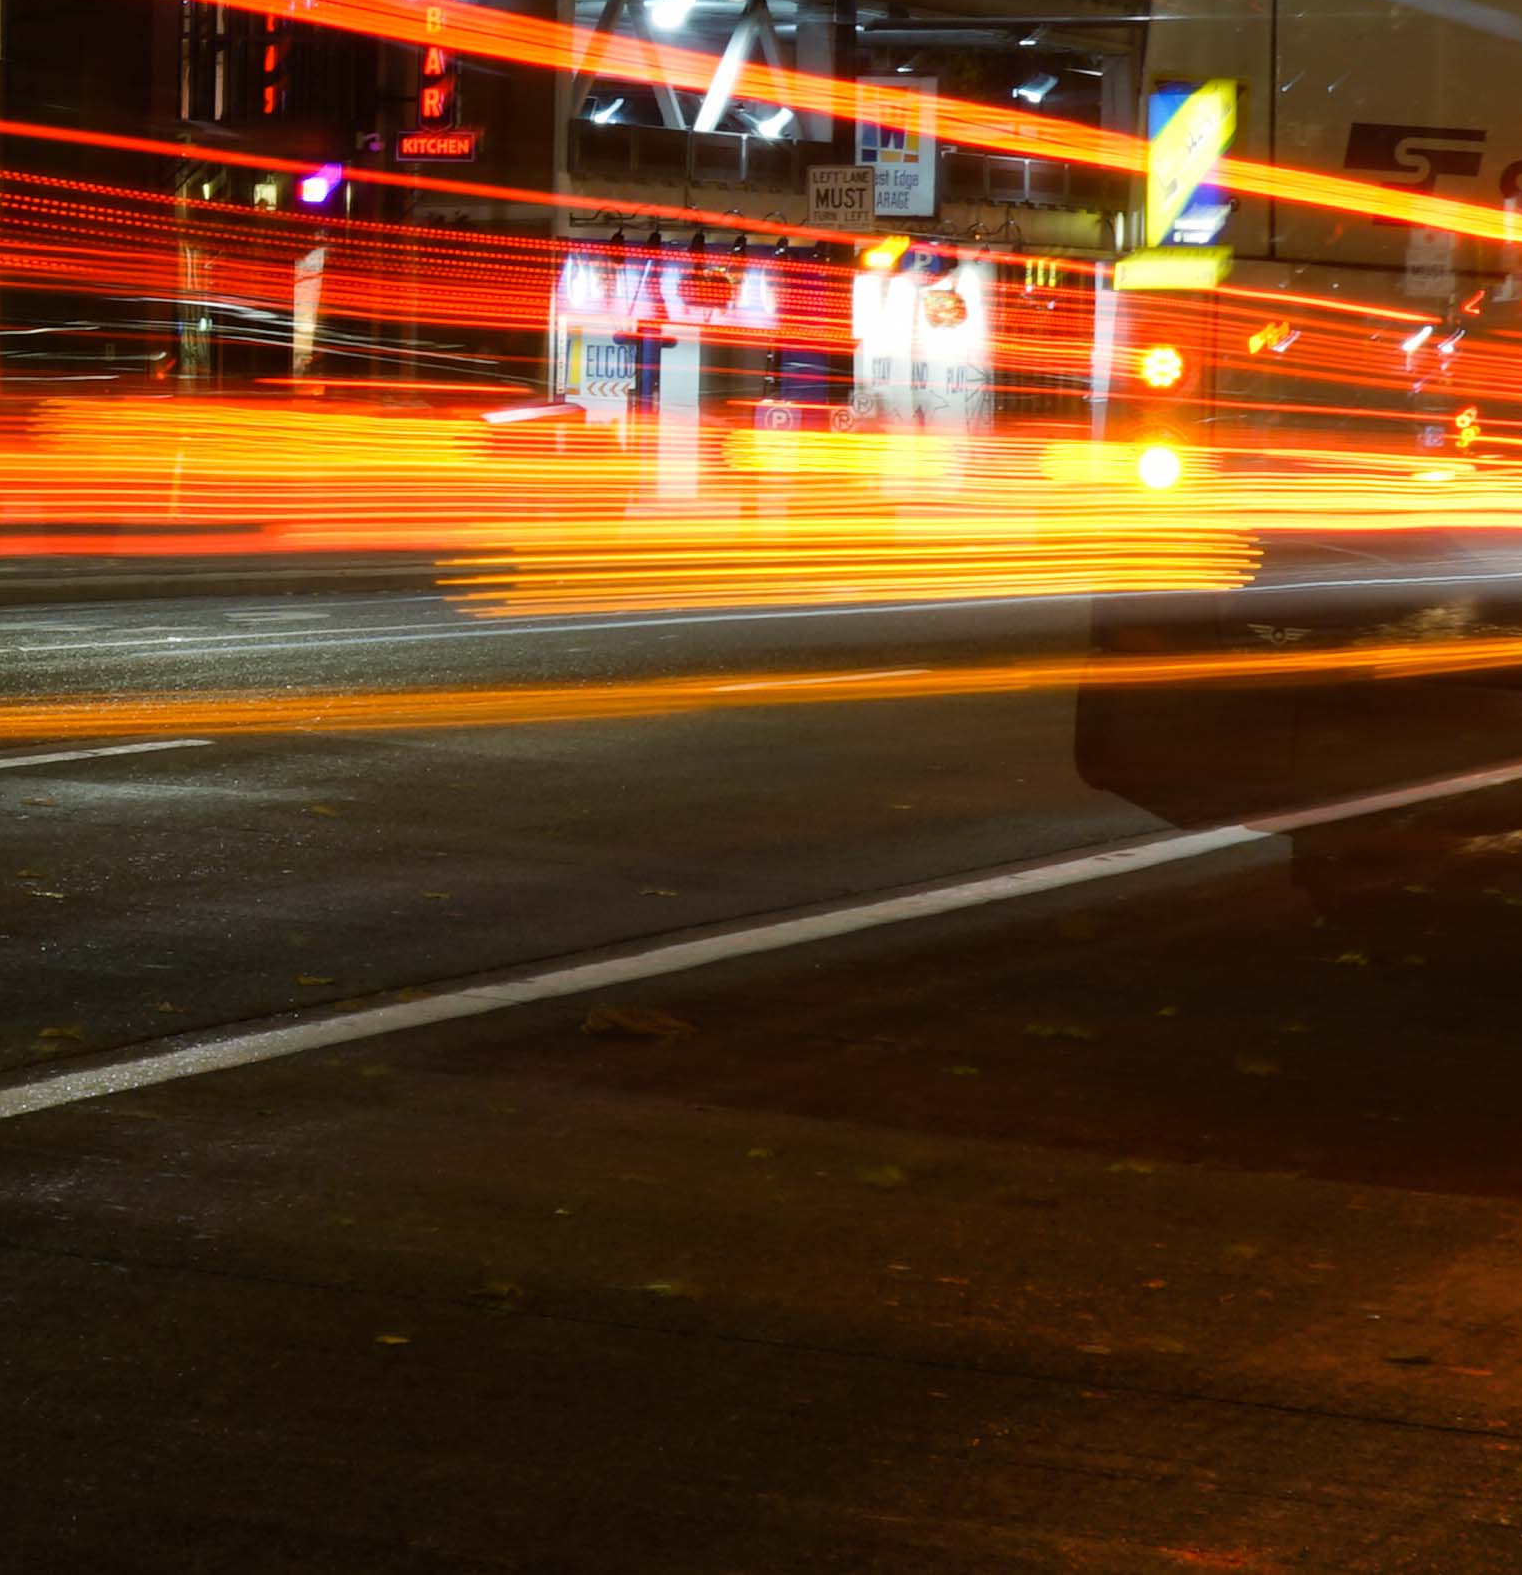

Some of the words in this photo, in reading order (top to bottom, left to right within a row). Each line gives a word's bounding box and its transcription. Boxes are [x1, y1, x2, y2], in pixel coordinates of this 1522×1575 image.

[422, 7, 443, 117] BAR
[402, 138, 469, 155] KITCHEN
[812, 171, 842, 184] LEFT
[843, 171, 870, 184] LANE
[874, 170, 889, 187] est
[816, 188, 866, 209] MUST
[876, 191, 910, 210] ARAGE
